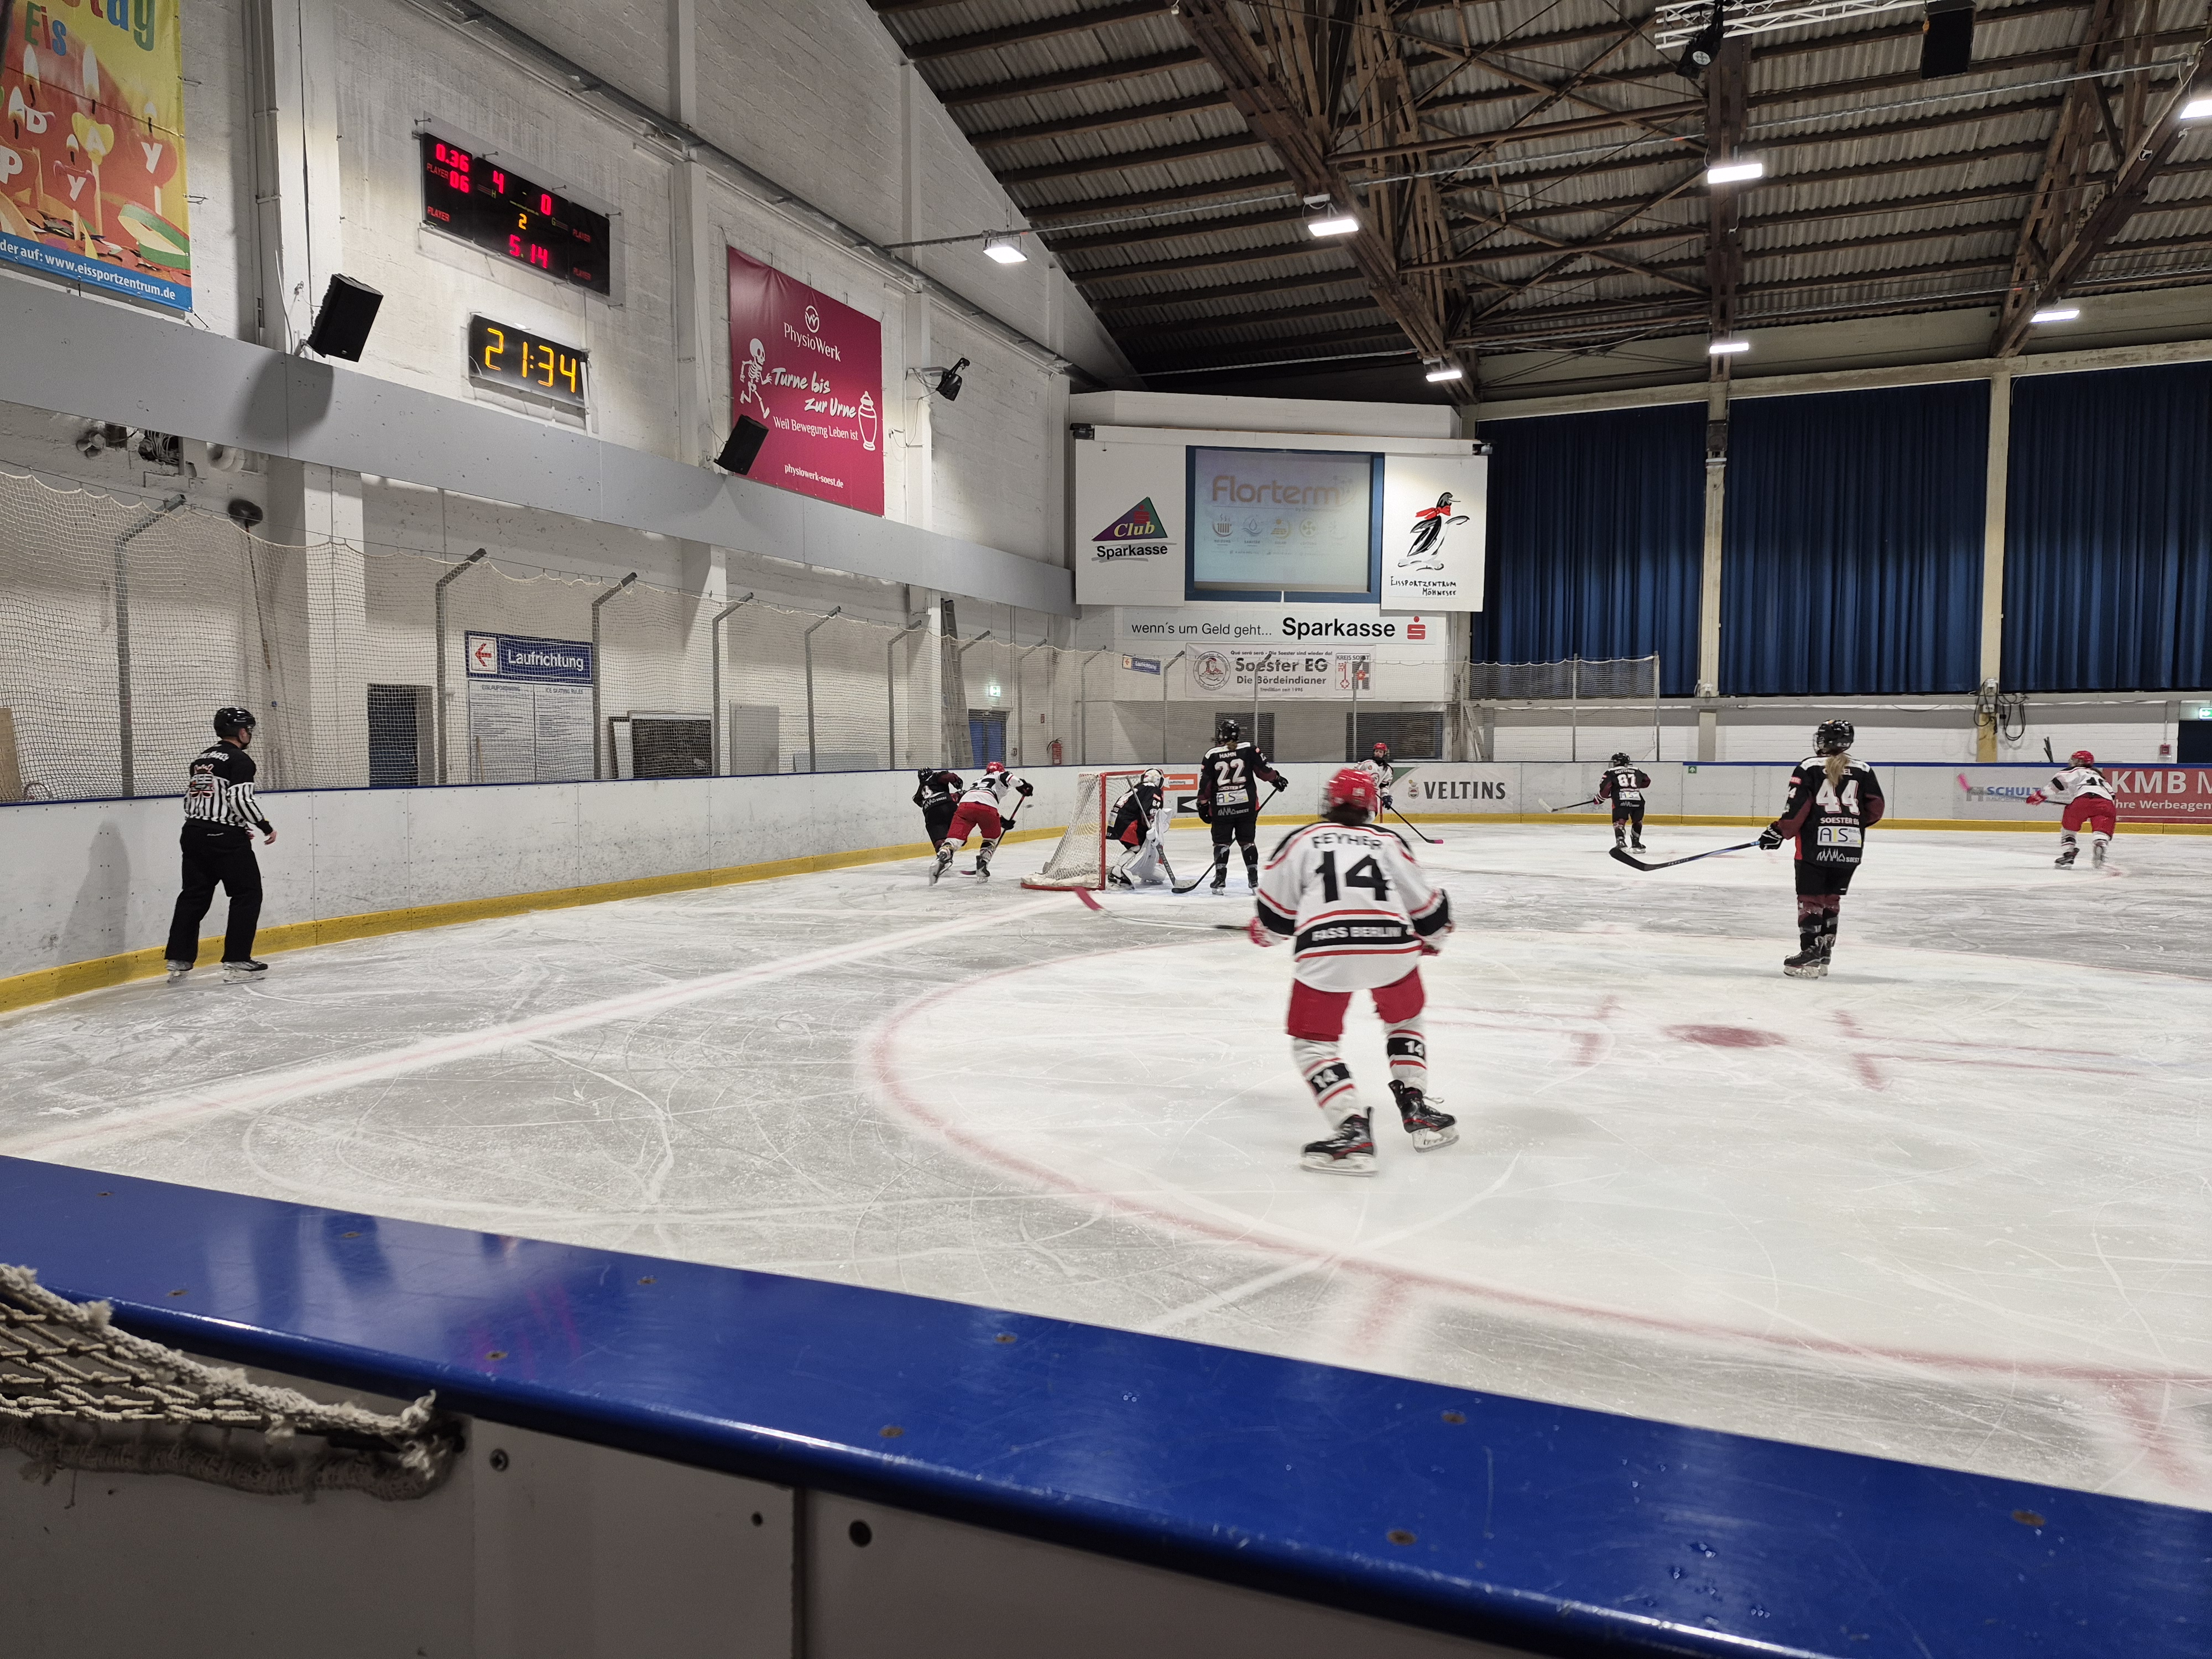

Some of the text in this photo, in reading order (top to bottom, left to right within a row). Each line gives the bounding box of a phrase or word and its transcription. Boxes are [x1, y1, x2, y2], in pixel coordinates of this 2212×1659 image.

[24, 2, 66, 56] Eis
[426, 163, 469, 194] PLAYER 06
[493, 170, 504, 194] 4
[427, 206, 450, 222] PLAYER
[540, 194, 551, 216] 0
[518, 213, 527, 230] 2
[20, 248, 43, 262] auf:
[45, 254, 176, 300] www.eissportzentrum.de
[783, 322, 841, 362] PhysioWerk
[485, 327, 576, 393] 21:34
[771, 367, 831, 394] Turne bis
[830, 397, 857, 419] Urne
[773, 416, 859, 440] Weil Bewegung Leben ist
[784, 463, 844, 488] physiowerk-soest.de
[1212, 475, 1341, 504] Florterm
[1114, 521, 1155, 538] Club
[1097, 545, 1168, 560] Sparkasse
[1178, 625, 1197, 634] um
[1202, 623, 1230, 634] Geld
[1234, 624, 1272, 638] geht...
[1282, 617, 1395, 640] Sparkasse
[507, 649, 584, 671] Laufrichtung
[1235, 658, 1328, 672] Soester EG
[1237, 675, 1253, 684] Die
[1214, 758, 1246, 787] 22
[2111, 771, 2187, 794] KMB
[1423, 781, 1506, 800] VELTINS
[1815, 778, 1860, 816] 44
[2140, 799, 2212, 812] Werbeagen
[1820, 816, 1853, 825] SOESTER
[1315, 850, 1391, 904] 14
[1404, 1040, 1425, 1057] 14
